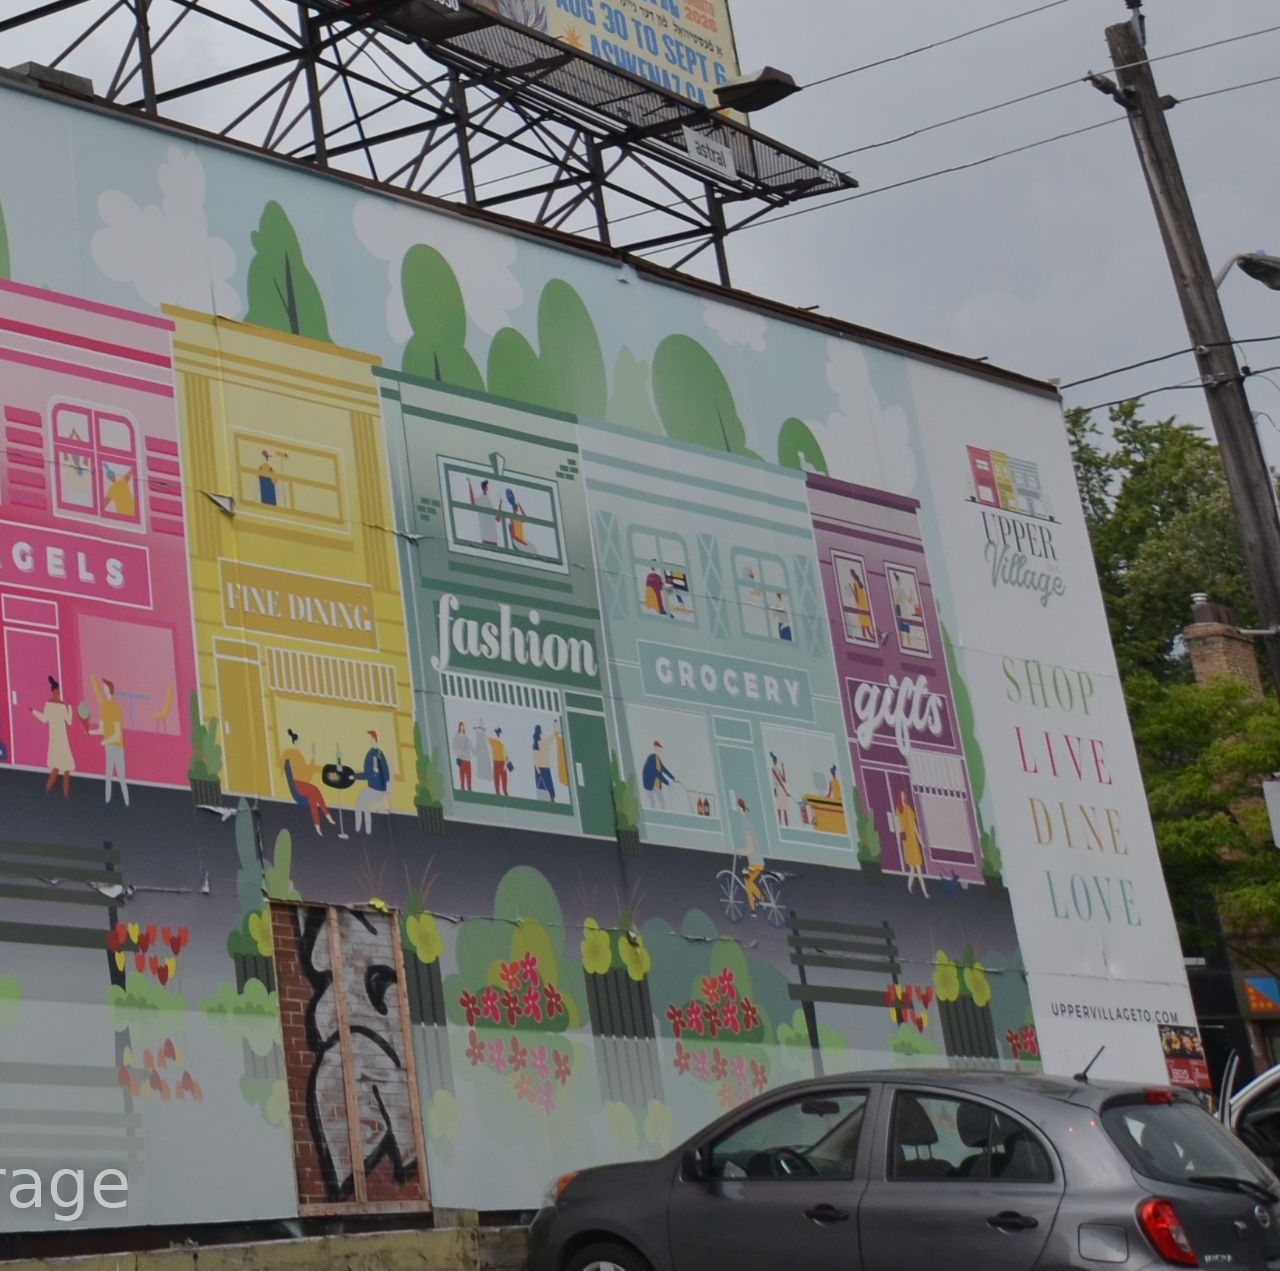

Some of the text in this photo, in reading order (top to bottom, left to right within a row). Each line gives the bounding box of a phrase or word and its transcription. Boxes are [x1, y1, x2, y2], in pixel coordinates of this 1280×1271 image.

[600, 1, 629, 41] 30
[631, 18, 659, 56] TO
[662, 33, 709, 83] SEPT
[713, 61, 727, 85] 6
[695, 140, 727, 169] astral
[981, 511, 1058, 561] UPPER
[984, 540, 1065, 608] Village
[226, 582, 373, 632] FINE DINING
[430, 592, 598, 678] fashion
[655, 655, 801, 706] GROCERY
[1001, 655, 1095, 715] SHOP
[854, 674, 943, 756] gifts
[1014, 726, 1113, 785] LIVE
[1028, 797, 1128, 856] DINE
[1045, 870, 1142, 927] LOVE
[1051, 1002, 1179, 1024] UPPERVILLAGETO.COM
